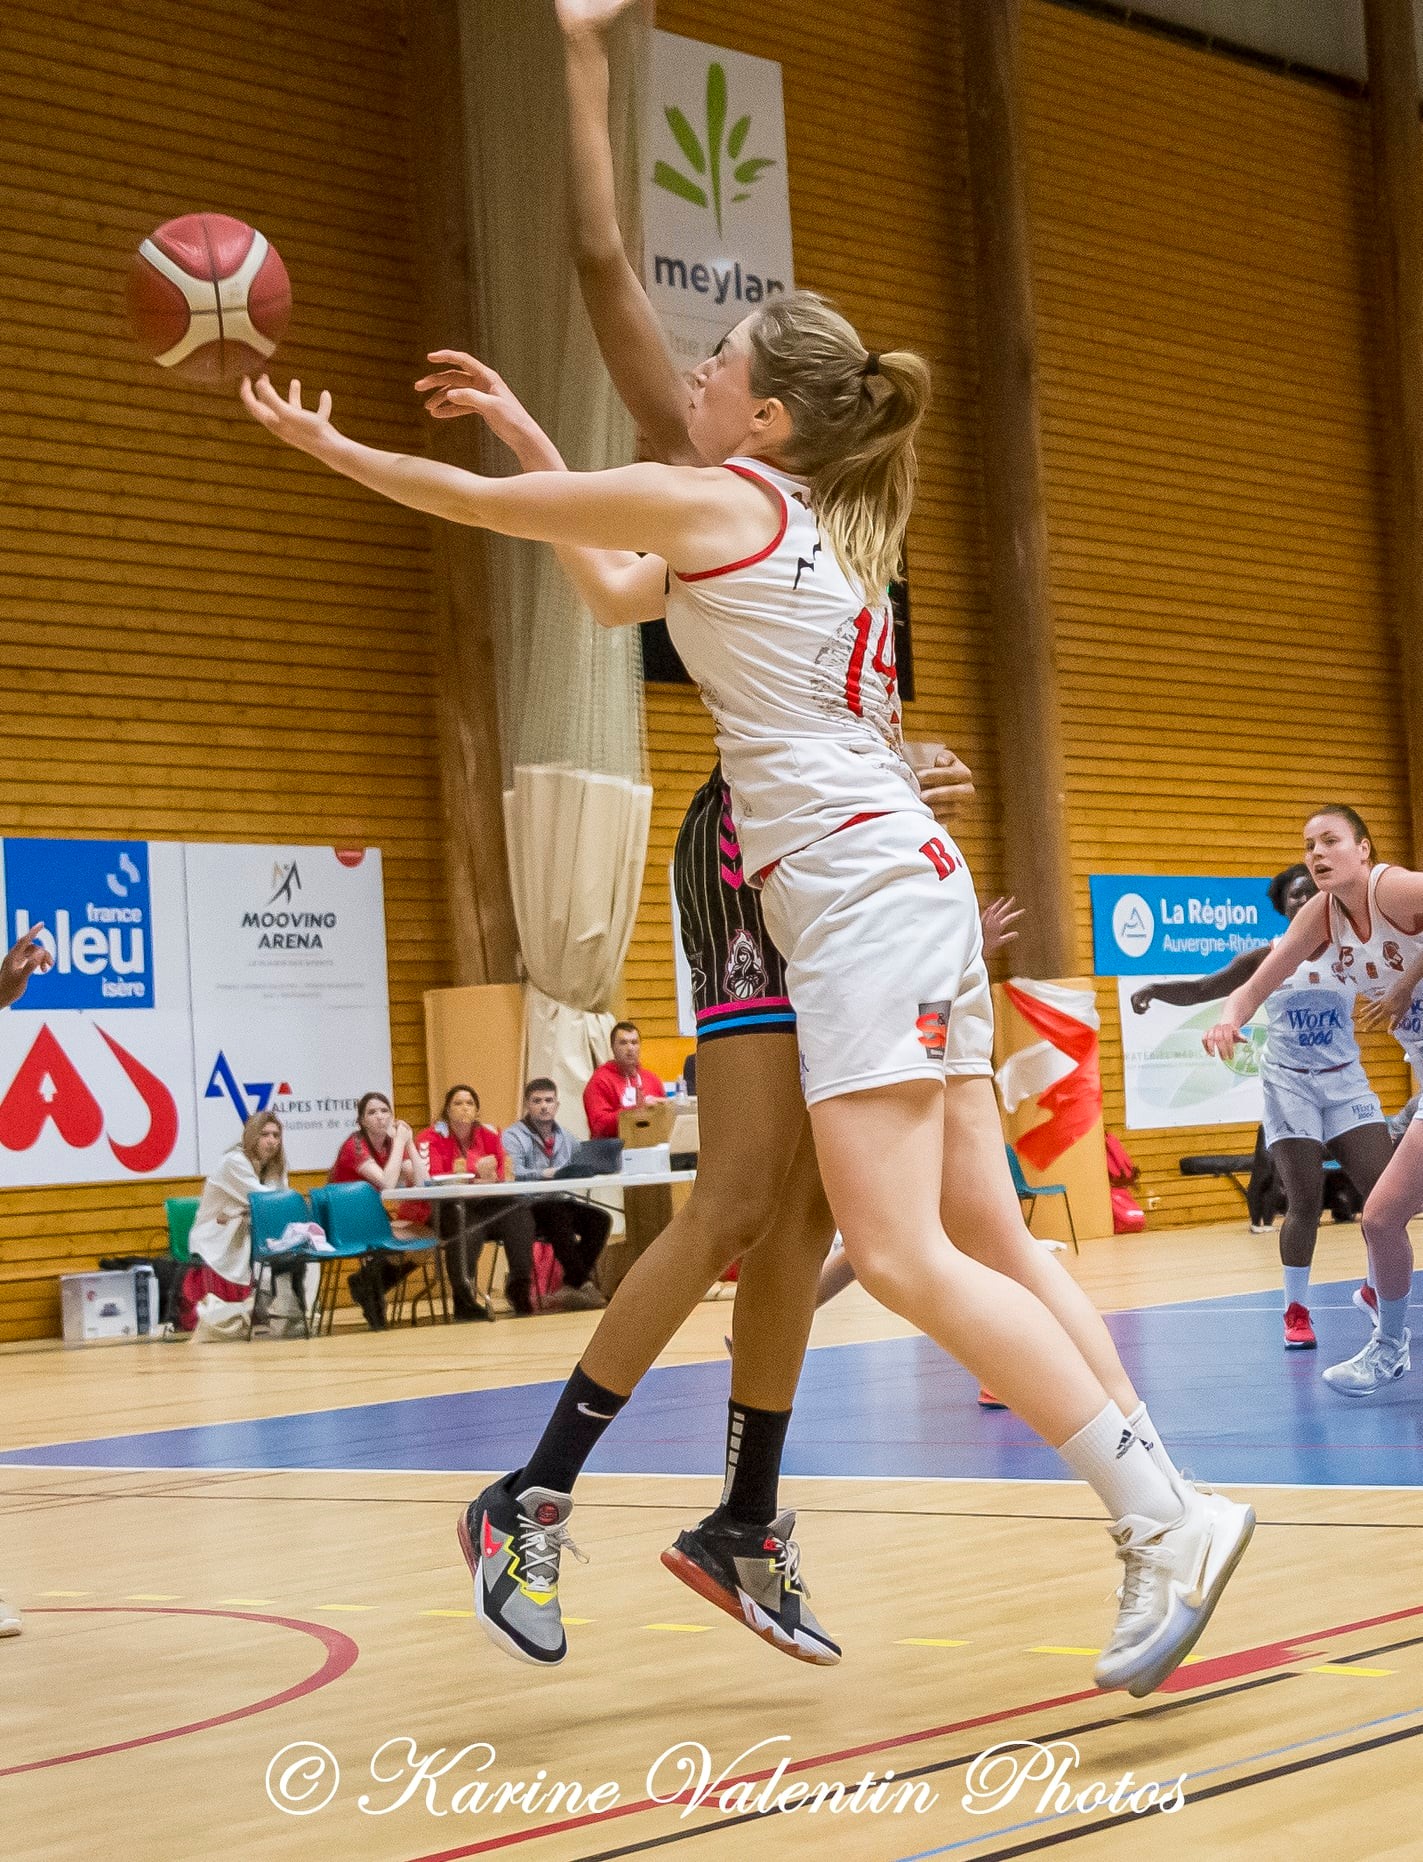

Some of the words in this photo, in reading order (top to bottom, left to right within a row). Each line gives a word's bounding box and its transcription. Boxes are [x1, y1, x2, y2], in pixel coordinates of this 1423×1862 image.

[86, 902, 143, 923] france
[241, 912, 337, 929] MOOVING
[1160, 898, 1185, 925] La
[1187, 898, 1258, 931] Région
[15, 909, 145, 975] bleu
[258, 933, 324, 950] ARENA
[1163, 933, 1287, 957] Auvergne-Rhône
[101, 976, 146, 998] isère
[271, 1100, 313, 1114] ALPES
[316, 1096, 360, 1112] TÉTIER
